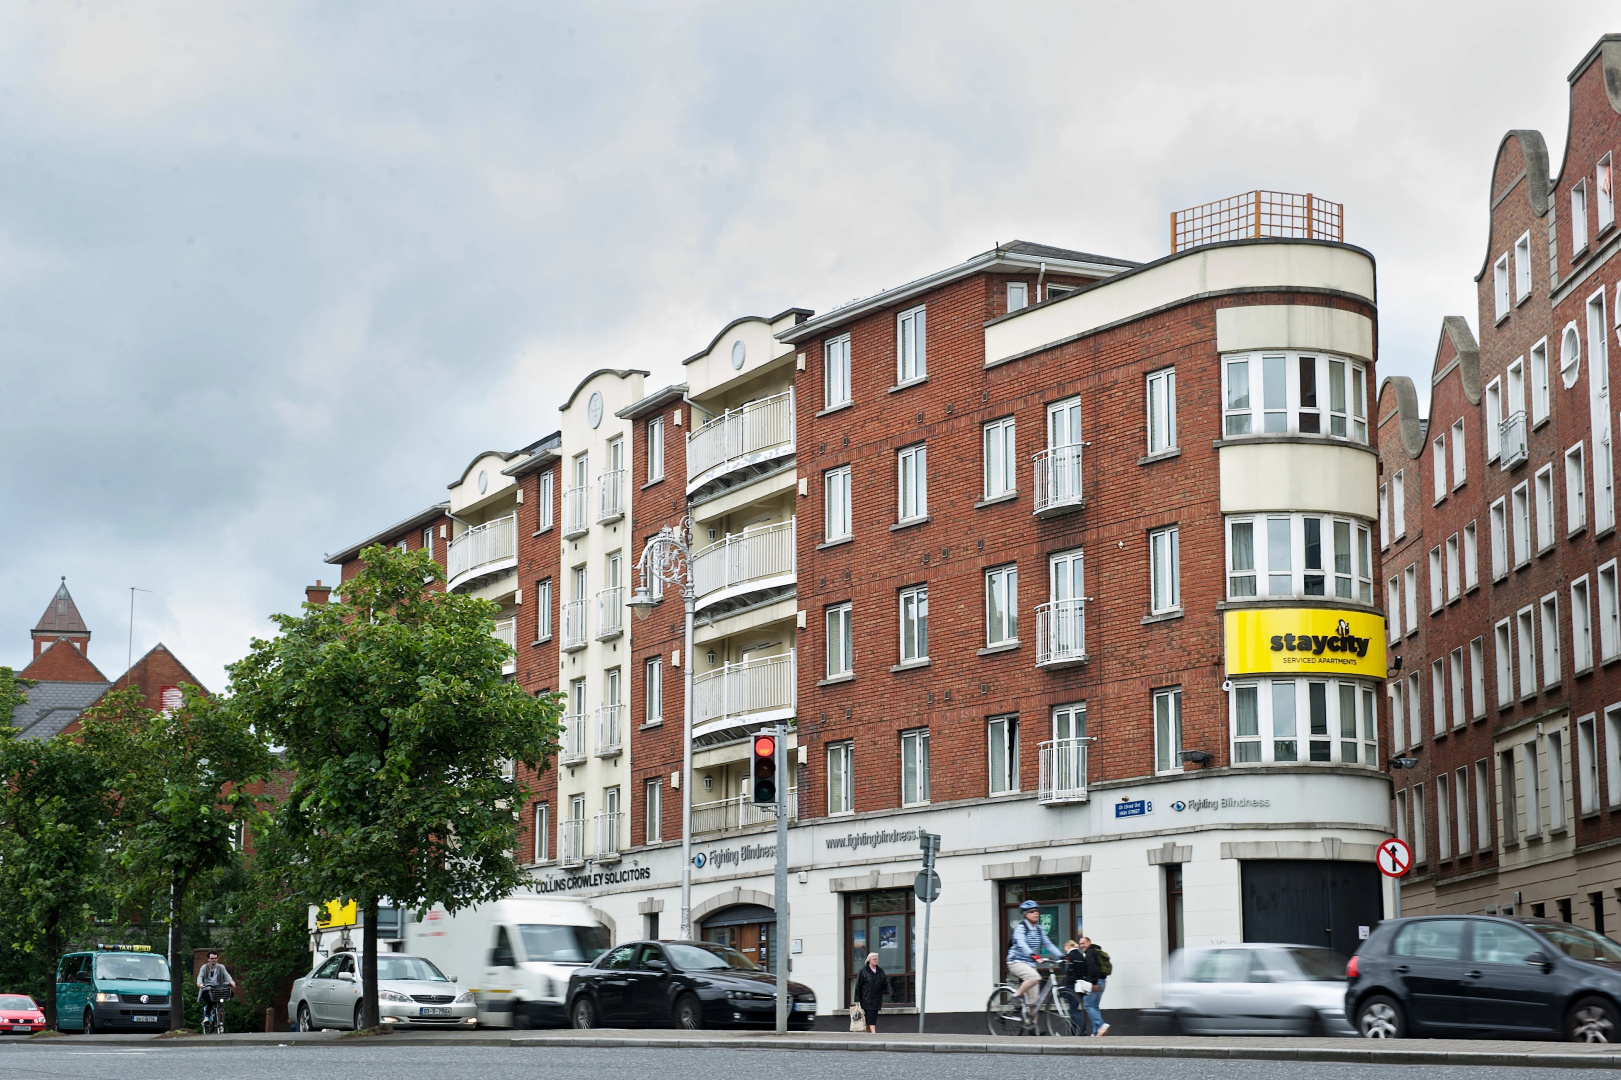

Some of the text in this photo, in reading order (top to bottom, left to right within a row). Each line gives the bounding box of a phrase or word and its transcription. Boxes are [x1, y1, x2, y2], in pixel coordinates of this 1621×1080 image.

[1270, 633, 1369, 657] staycity
[1318, 657, 1357, 665] APARTMENTS
[1147, 801, 1152, 812] 8
[1188, 797, 1270, 811] Fighting Blindness
[709, 848, 739, 868] Fighting
[535, 867, 651, 894] COLLINS CROWLEY SOLICITORS
